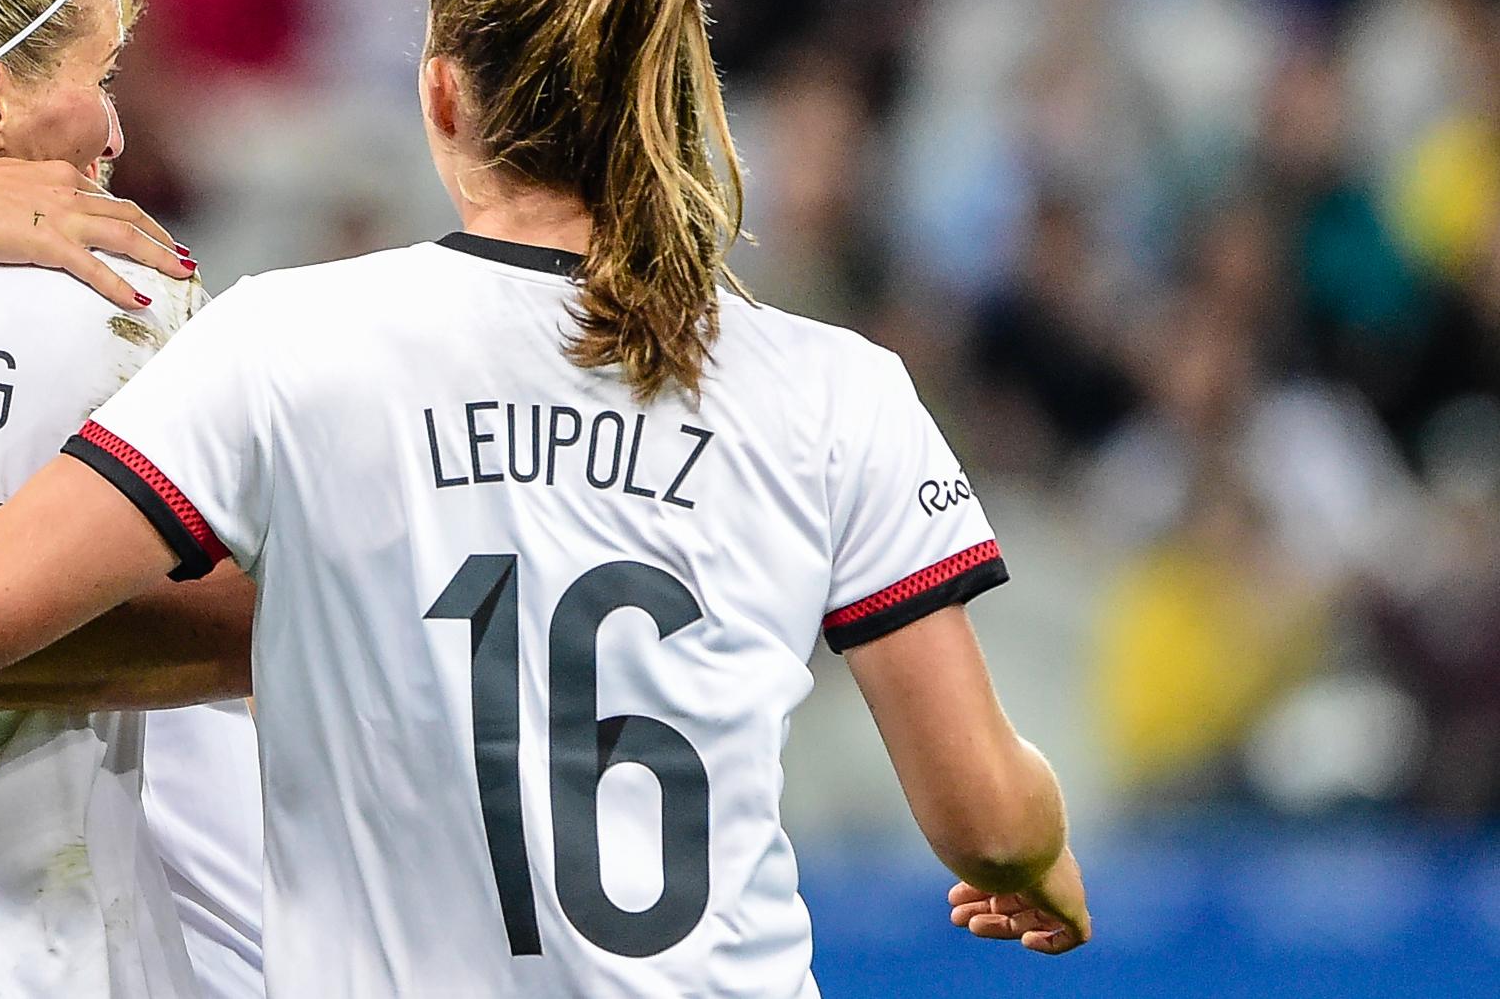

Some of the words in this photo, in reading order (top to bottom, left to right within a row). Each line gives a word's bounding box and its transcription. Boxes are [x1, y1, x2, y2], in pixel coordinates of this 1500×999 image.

[424, 401, 715, 510] LEUPOLZ
[918, 465, 973, 517] Rio
[422, 553, 710, 959] 16
